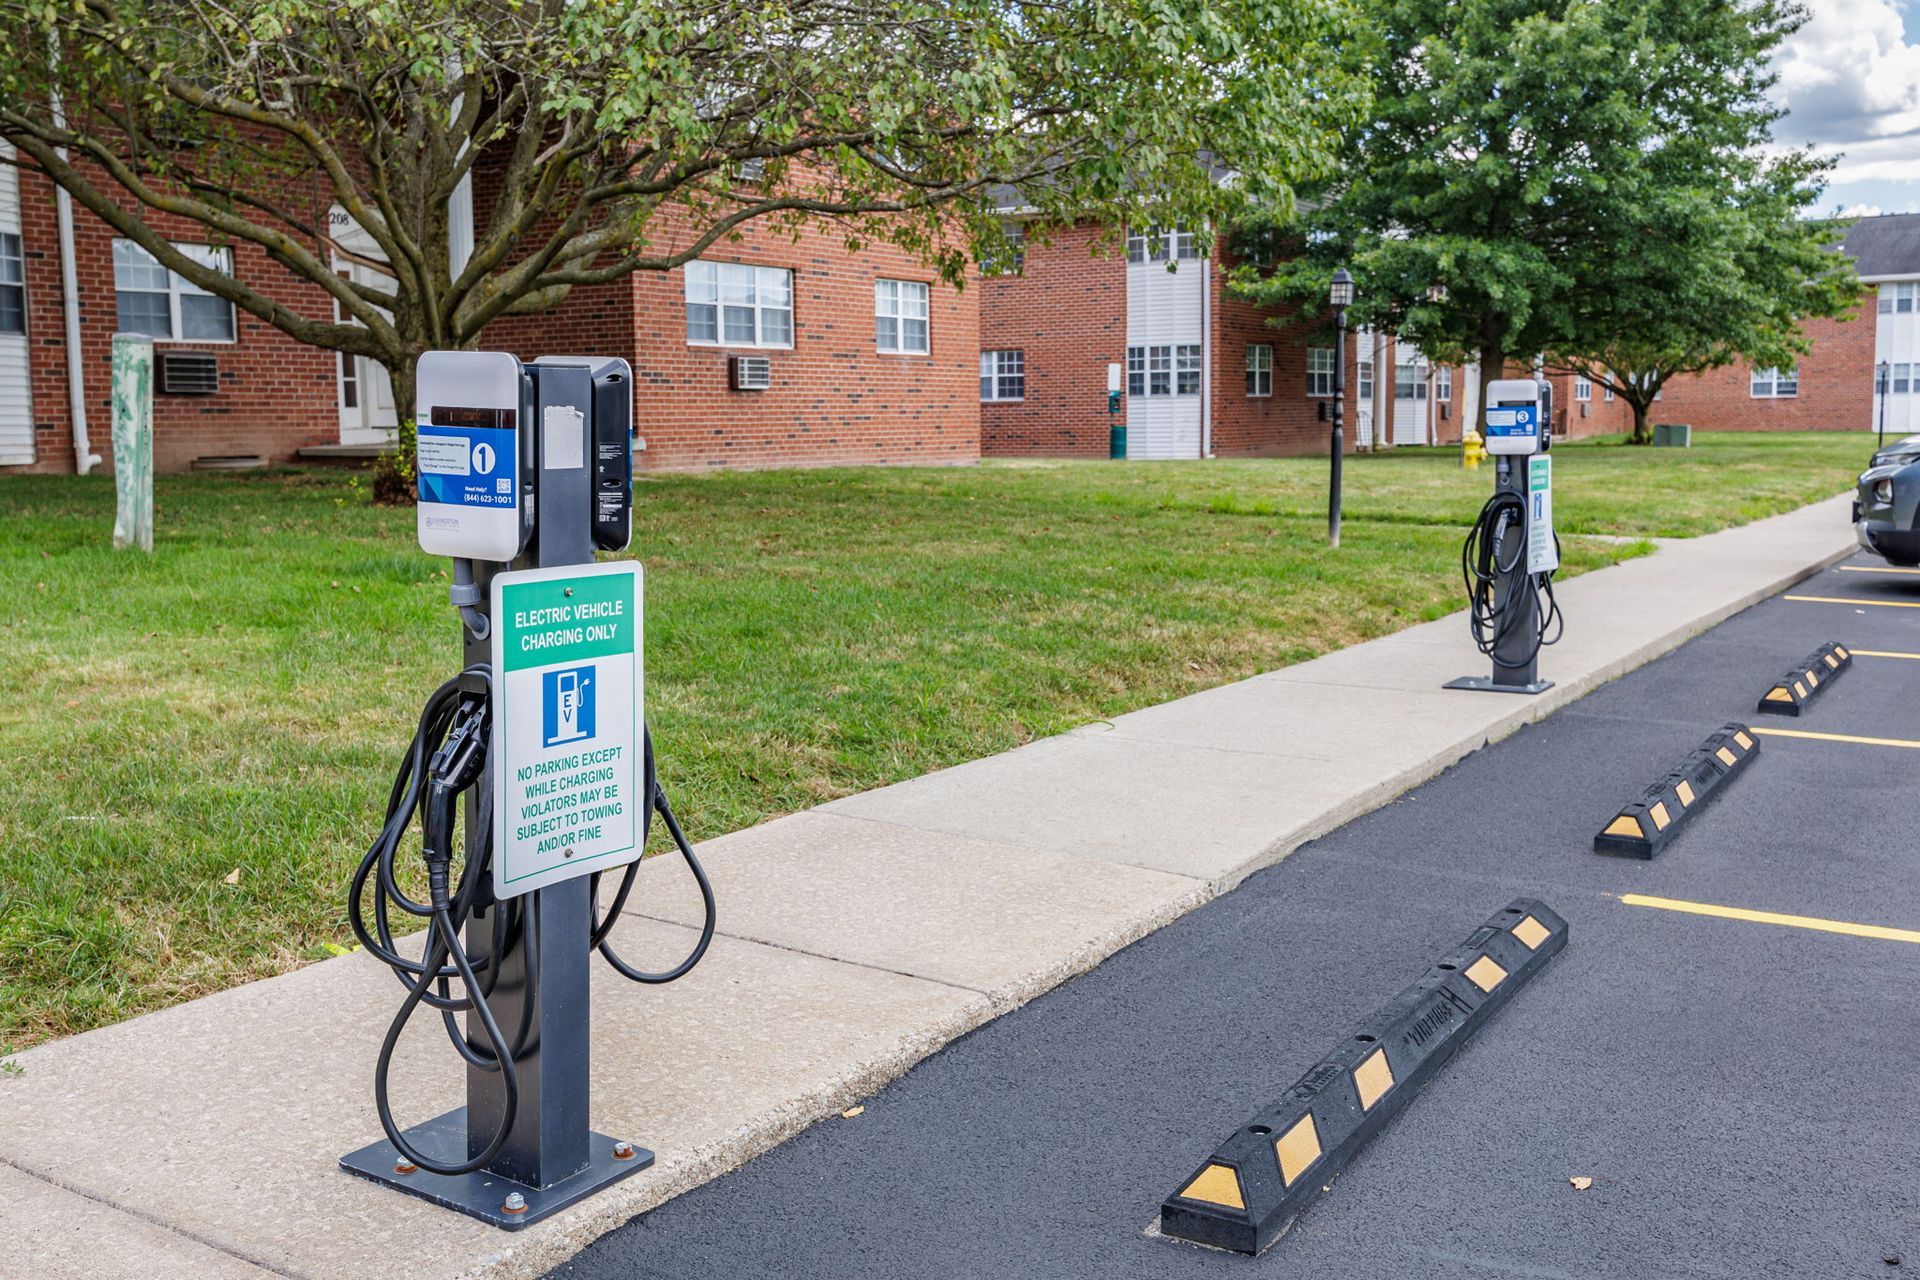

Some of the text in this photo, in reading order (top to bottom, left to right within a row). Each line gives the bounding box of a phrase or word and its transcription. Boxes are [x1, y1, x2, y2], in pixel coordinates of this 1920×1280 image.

[1519, 412, 1527, 422] 3
[478, 446, 487, 472] 1
[463, 494, 512, 504] (844) 623-1001
[515, 600, 623, 628] ELECTRIC VEHICLE
[521, 623, 617, 651] CHARGING ONLY
[517, 747, 623, 782] NO PARKING EXCEPT
[525, 767, 614, 799] WHILE CHARGING
[521, 784, 618, 820] VIOLATORS MAY BE
[516, 802, 623, 841] SUBJECT TO TOWING
[537, 825, 602, 855] AND/OR FINE
